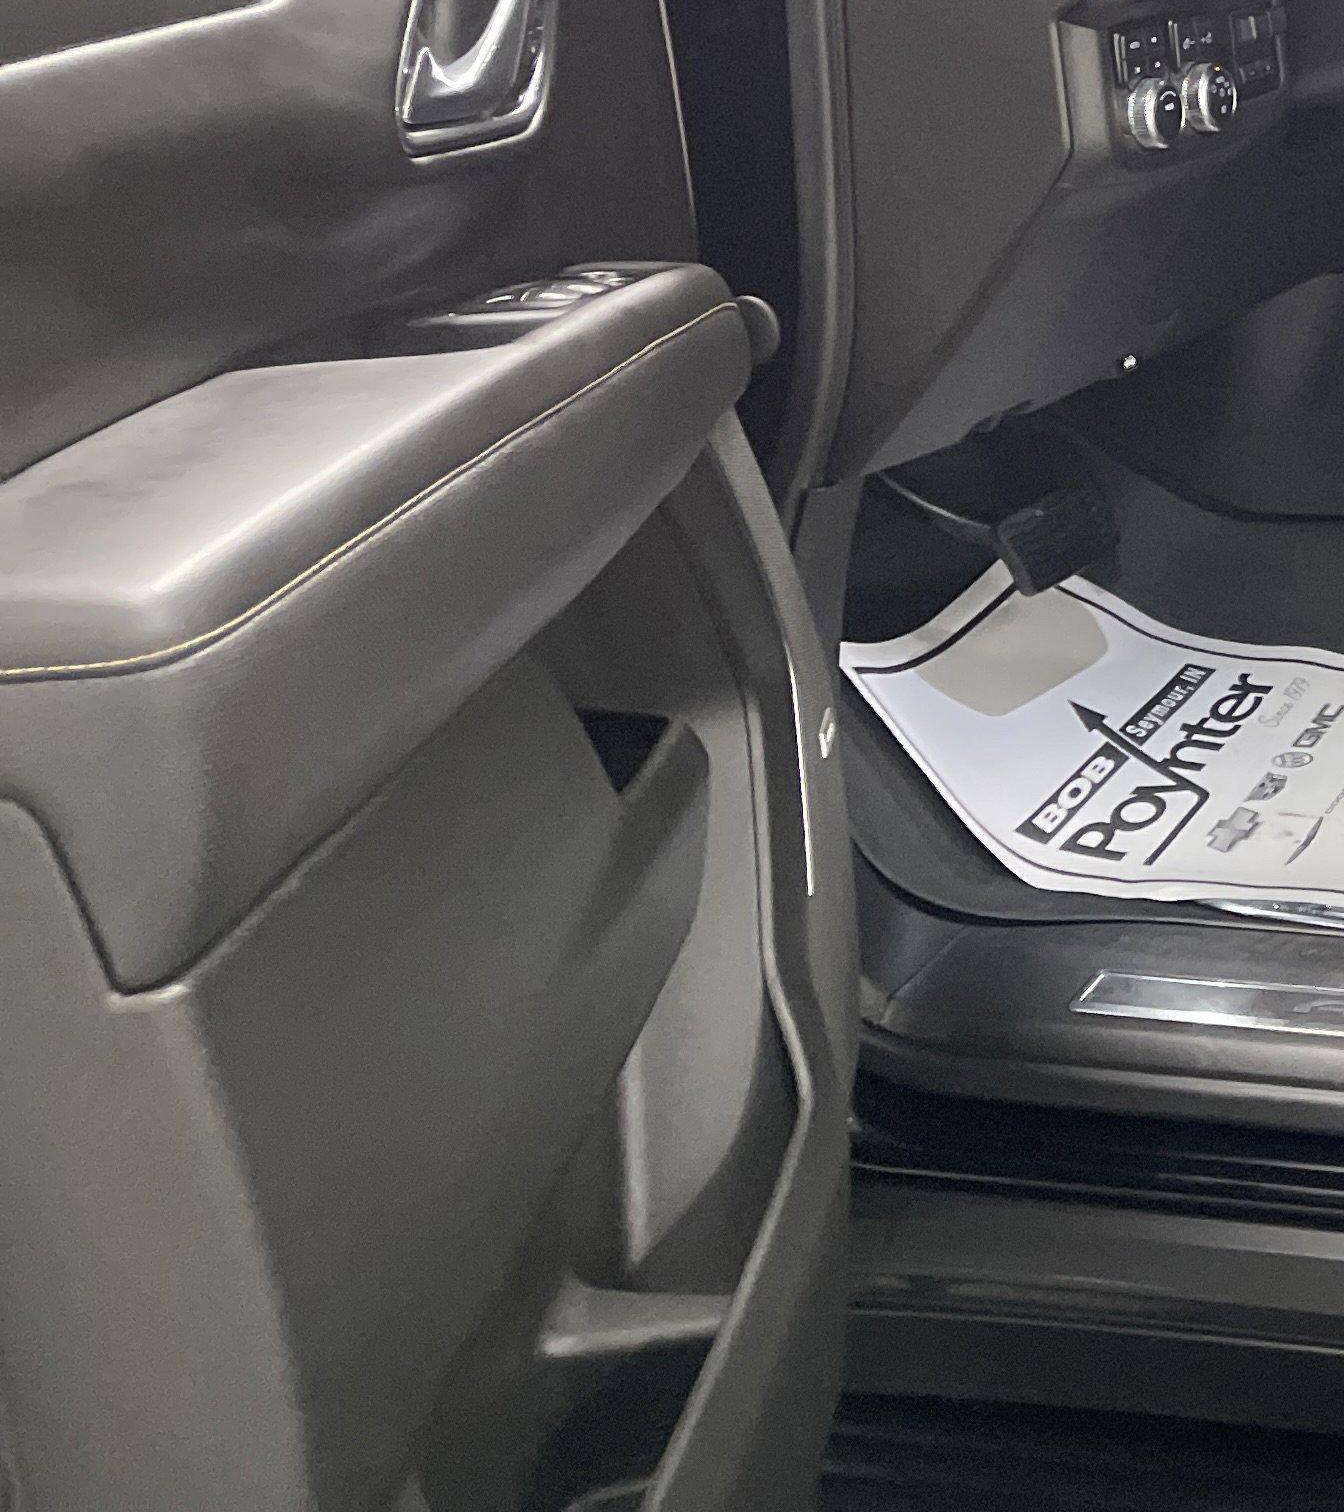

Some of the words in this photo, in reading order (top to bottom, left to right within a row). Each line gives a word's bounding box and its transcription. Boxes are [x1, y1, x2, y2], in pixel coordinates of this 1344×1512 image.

[1126, 685, 1196, 738] Seymour,
[1180, 667, 1207, 684] IN
[1031, 755, 1116, 834] BOB
[1058, 673, 1273, 865] Poynter
